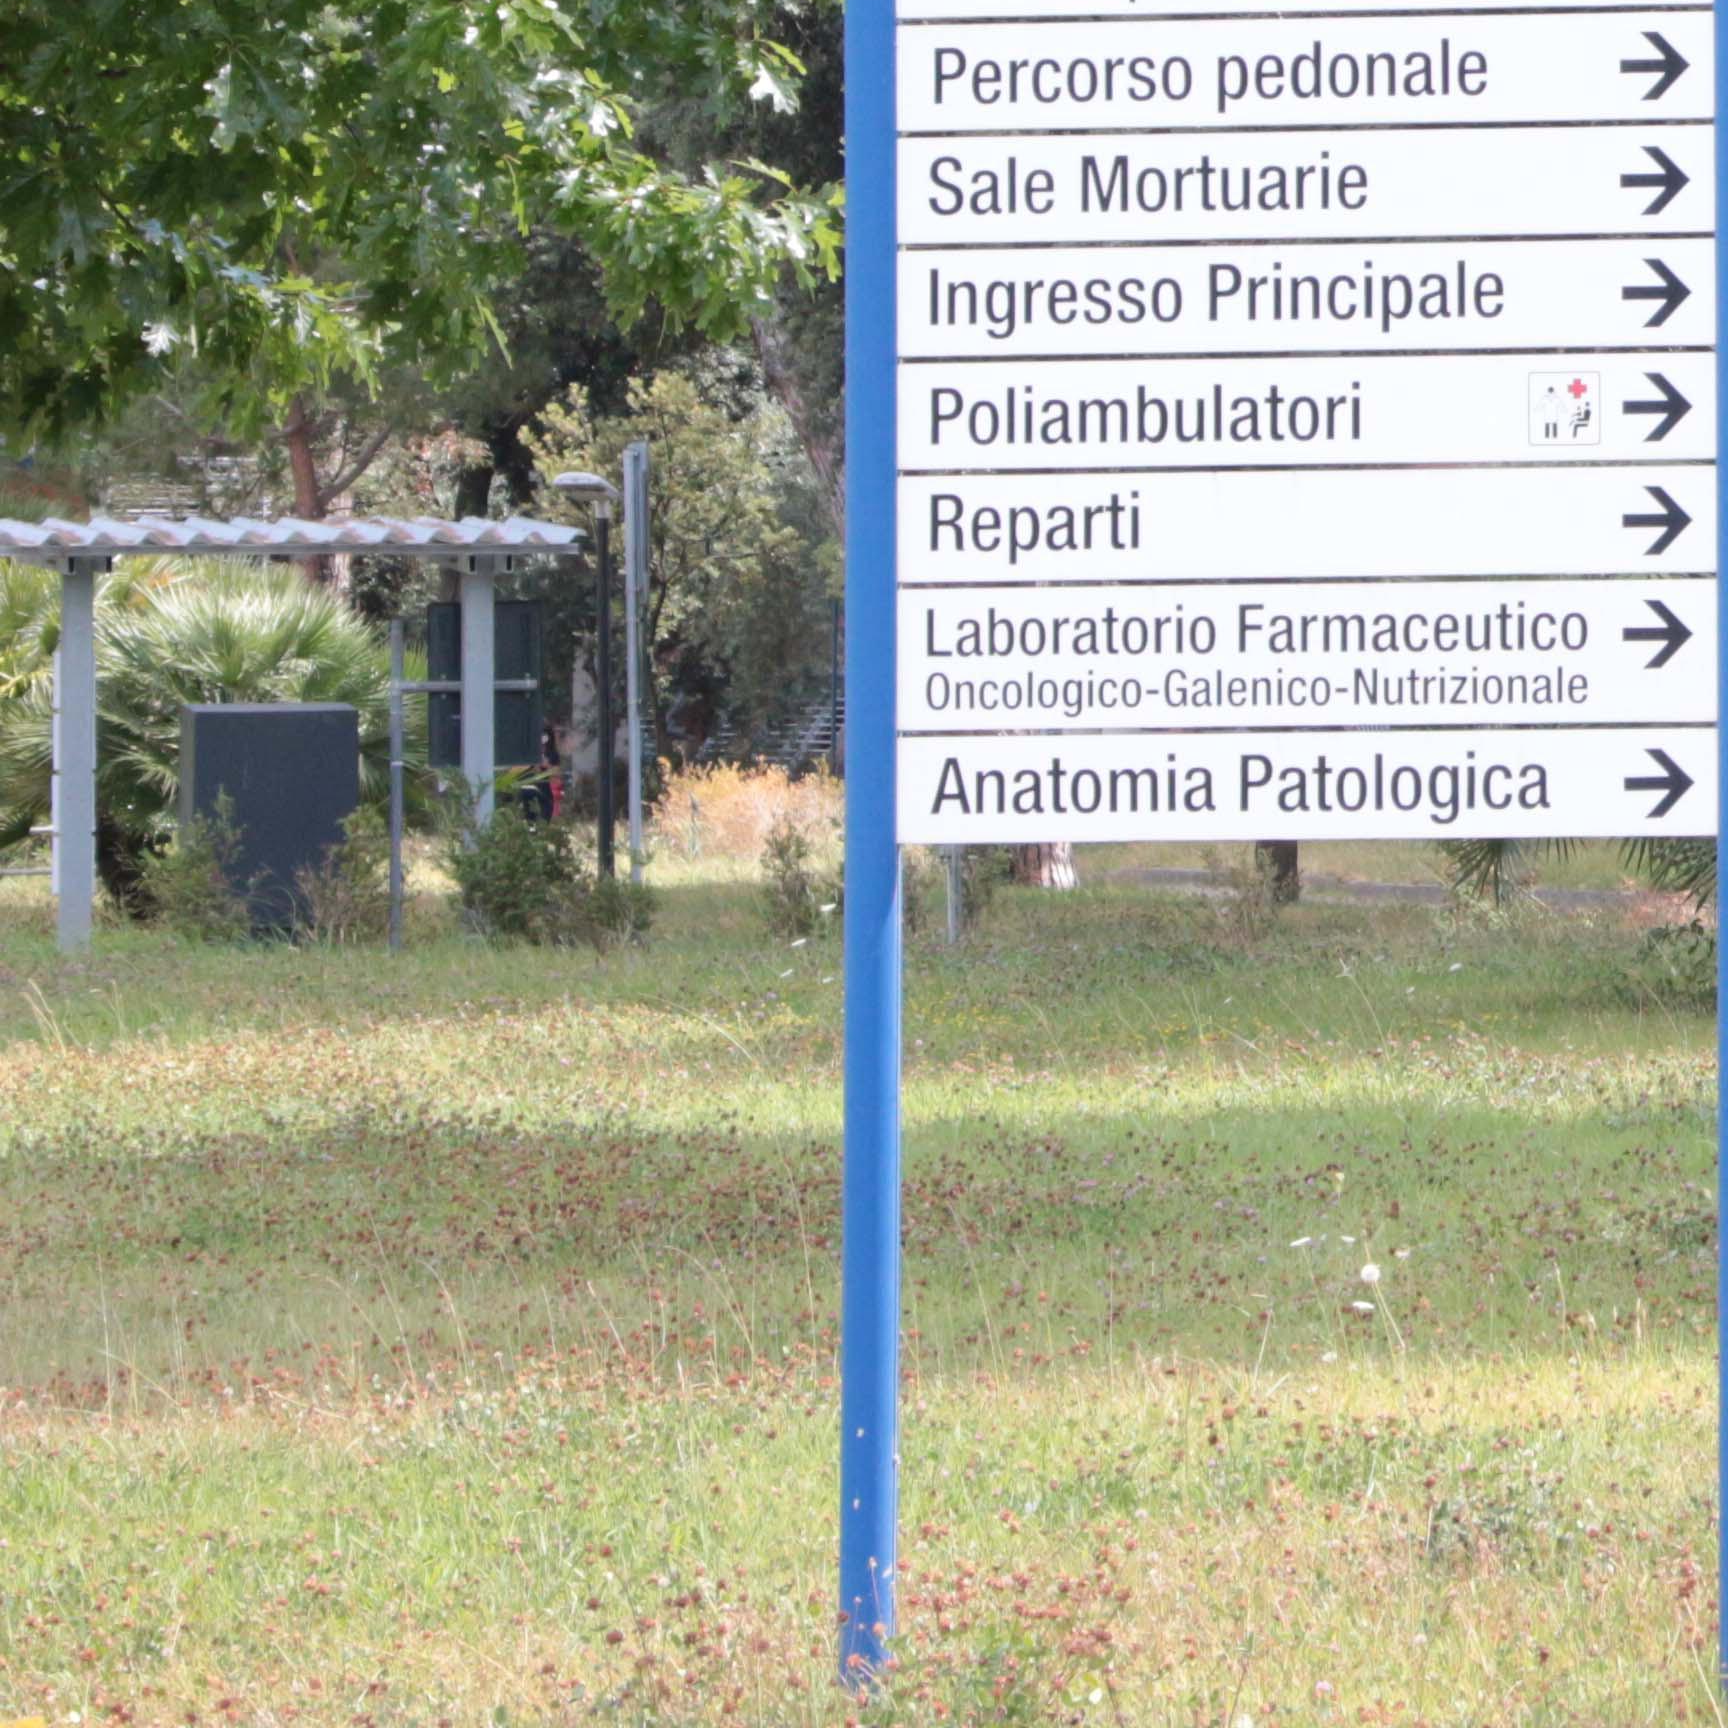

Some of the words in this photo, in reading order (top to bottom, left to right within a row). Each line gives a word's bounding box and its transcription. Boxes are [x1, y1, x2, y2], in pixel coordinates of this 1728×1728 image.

[934, 47, 1192, 105] Percorso
[1217, 38, 1488, 114] pedonale
[928, 156, 1055, 216] Sale
[1081, 151, 1368, 213] Mortuarie
[929, 268, 1183, 339] Ingresso
[1208, 260, 1504, 333] Principale
[930, 381, 1361, 446] Poliambulatori
[930, 490, 1140, 564] Reparti
[926, 607, 1216, 658] Laboratorio
[1238, 601, 1588, 654] Farmaceutico
[926, 666, 1588, 718] Oncologico-Galenico-Nutrizionale
[931, 753, 1216, 815] Anatomia
[1239, 750, 1551, 825] Patologica
